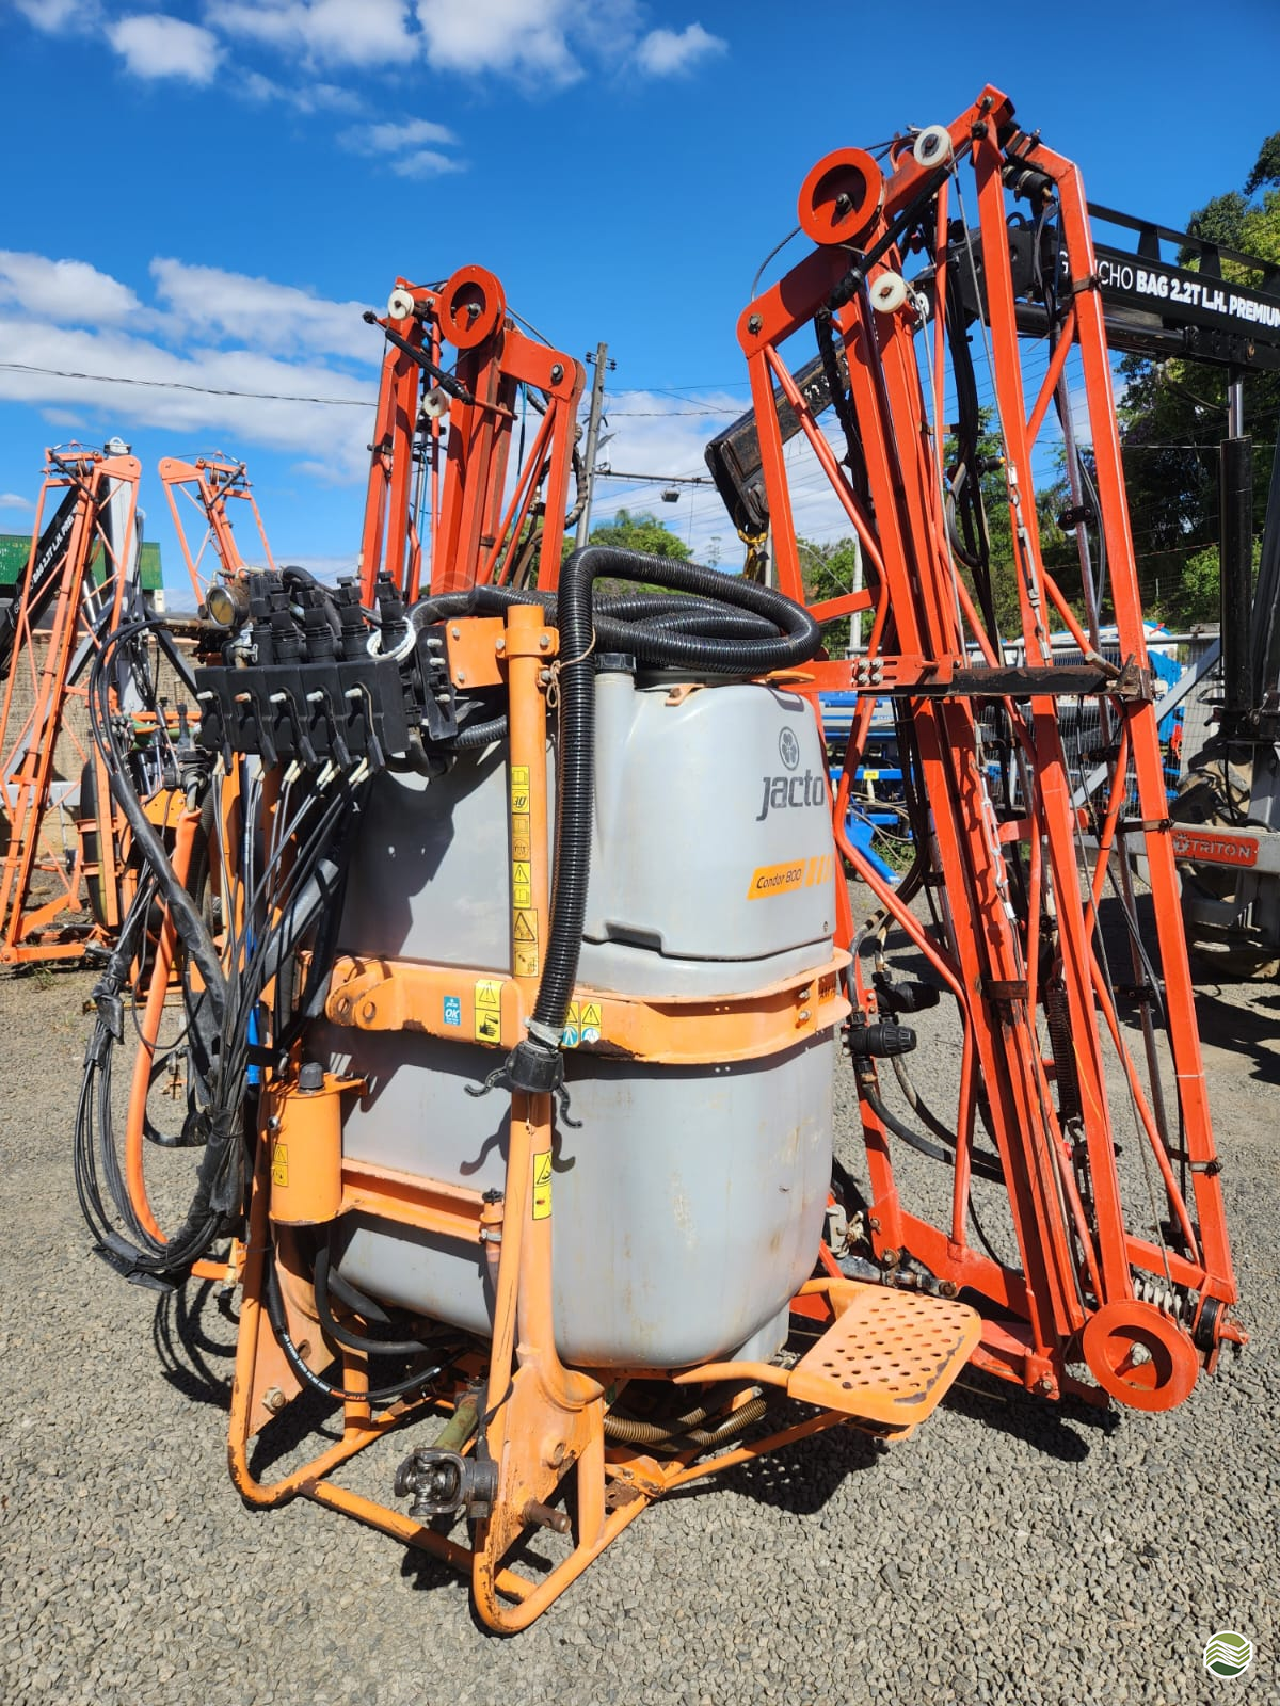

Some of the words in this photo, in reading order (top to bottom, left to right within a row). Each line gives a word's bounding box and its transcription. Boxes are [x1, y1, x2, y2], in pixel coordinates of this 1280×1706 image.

[1136, 270, 1169, 297] BAG
[1170, 278, 1201, 305] 2.2T
[756, 770, 825, 821] jacto
[1191, 840, 1251, 858] TRITON
[756, 873, 785, 889] Condor
[785, 868, 802, 883] 800
[445, 1009, 460, 1018] OK
